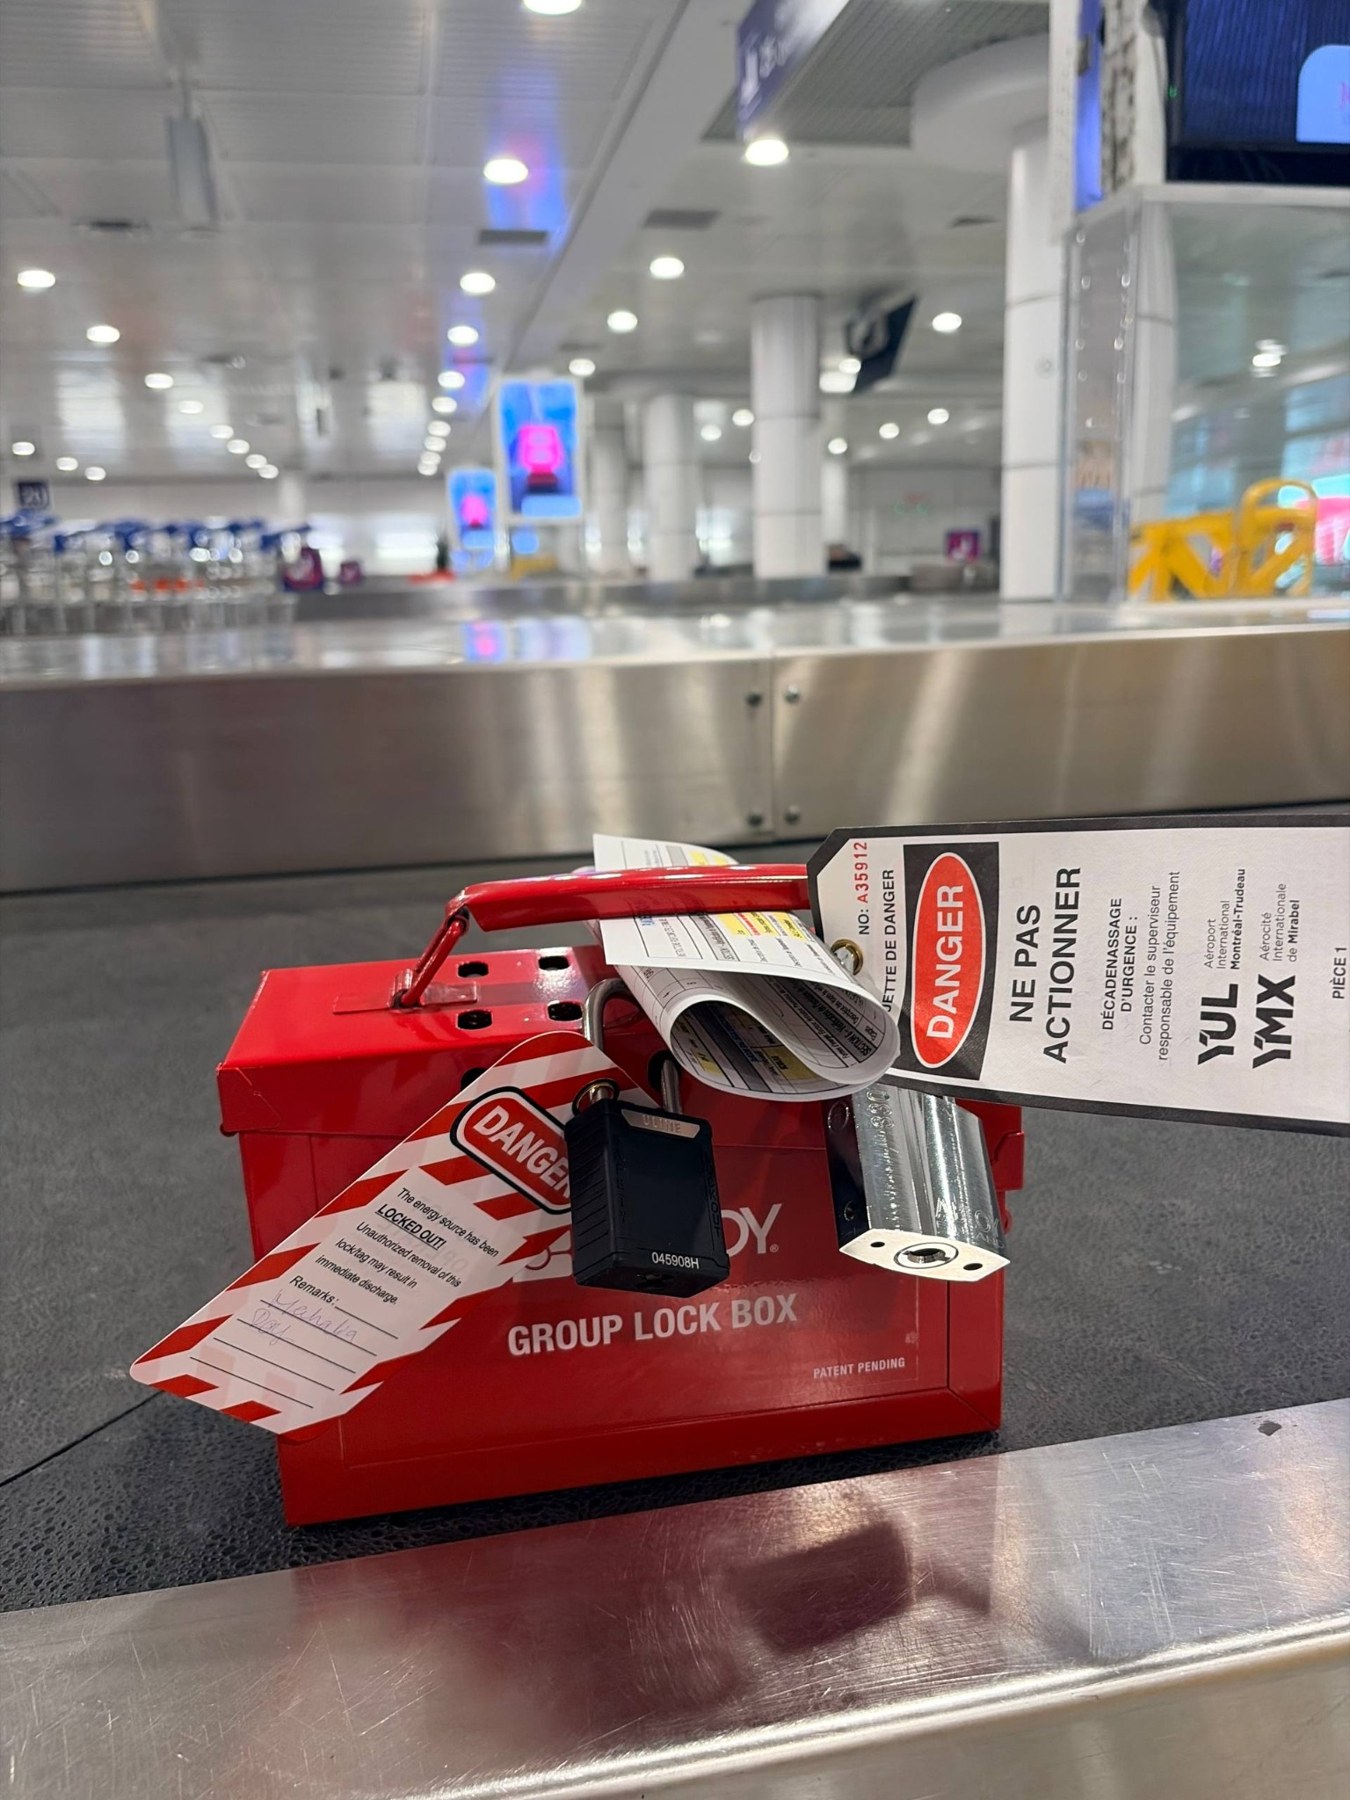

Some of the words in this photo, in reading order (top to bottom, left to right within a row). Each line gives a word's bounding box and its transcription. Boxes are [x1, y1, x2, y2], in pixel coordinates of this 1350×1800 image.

[853, 842, 869, 904] A35912
[883, 870, 896, 935] DANGER
[858, 910, 869, 934] NO:
[1014, 905, 1040, 967] PAS
[1147, 886, 1160, 960] superviseur
[1163, 872, 1180, 954] l'équipement
[1204, 919, 1216, 968] Aéroport
[1216, 901, 1230, 969] International
[1230, 869, 1245, 969] Montréal-Trudeau
[1259, 913, 1271, 961] Aérocité
[1273, 884, 1286, 961] Internationale
[1288, 900, 1299, 943] Mirabel
[885, 941, 896, 960] DE
[927, 886, 967, 1041] DANGER
[1044, 868, 1080, 1063] ACTIONNER
[1101, 899, 1124, 1030] DÉCADENASSAGE
[1144, 965, 1155, 976] le
[1162, 959, 1174, 983] de
[1287, 948, 1297, 962] de
[1330, 958, 1346, 999] PIÈCE
[1009, 980, 1035, 1021] NE
[1139, 980, 1154, 1044] Contacter
[1159, 988, 1172, 1060] responsable
[1198, 984, 1238, 1065] YUL
[1253, 974, 1295, 1068] YMX
[642, 1114, 681, 1133] ULINE
[377, 1204, 423, 1235] LOCKED
[420, 1229, 447, 1250] OUT!
[397, 1187, 415, 1204] The
[413, 1200, 440, 1222] energy
[439, 1216, 467, 1237] source
[464, 1231, 480, 1246] has
[479, 1240, 499, 1257] been
[315, 1255, 361, 1284] immediate
[358, 1276, 398, 1305] discharge.
[335, 1238, 370, 1263] lock/tag
[368, 1256, 387, 1273] may
[385, 1268, 410, 1285] result
[407, 1278, 418, 1289] in
[356, 1221, 412, 1258] Unauthorized
[407, 1250, 441, 1275] removal
[437, 1267, 450, 1282] of
[446, 1273, 461, 1288] this
[651, 1251, 700, 1270] 045908H
[290, 1275, 339, 1306] Remarks:
[508, 1314, 623, 1357] GROUP
[634, 1302, 721, 1341] LOCK
[732, 1293, 797, 1330] BOX
[813, 1363, 854, 1379] PATENT
[857, 1357, 905, 1373] PENDING
